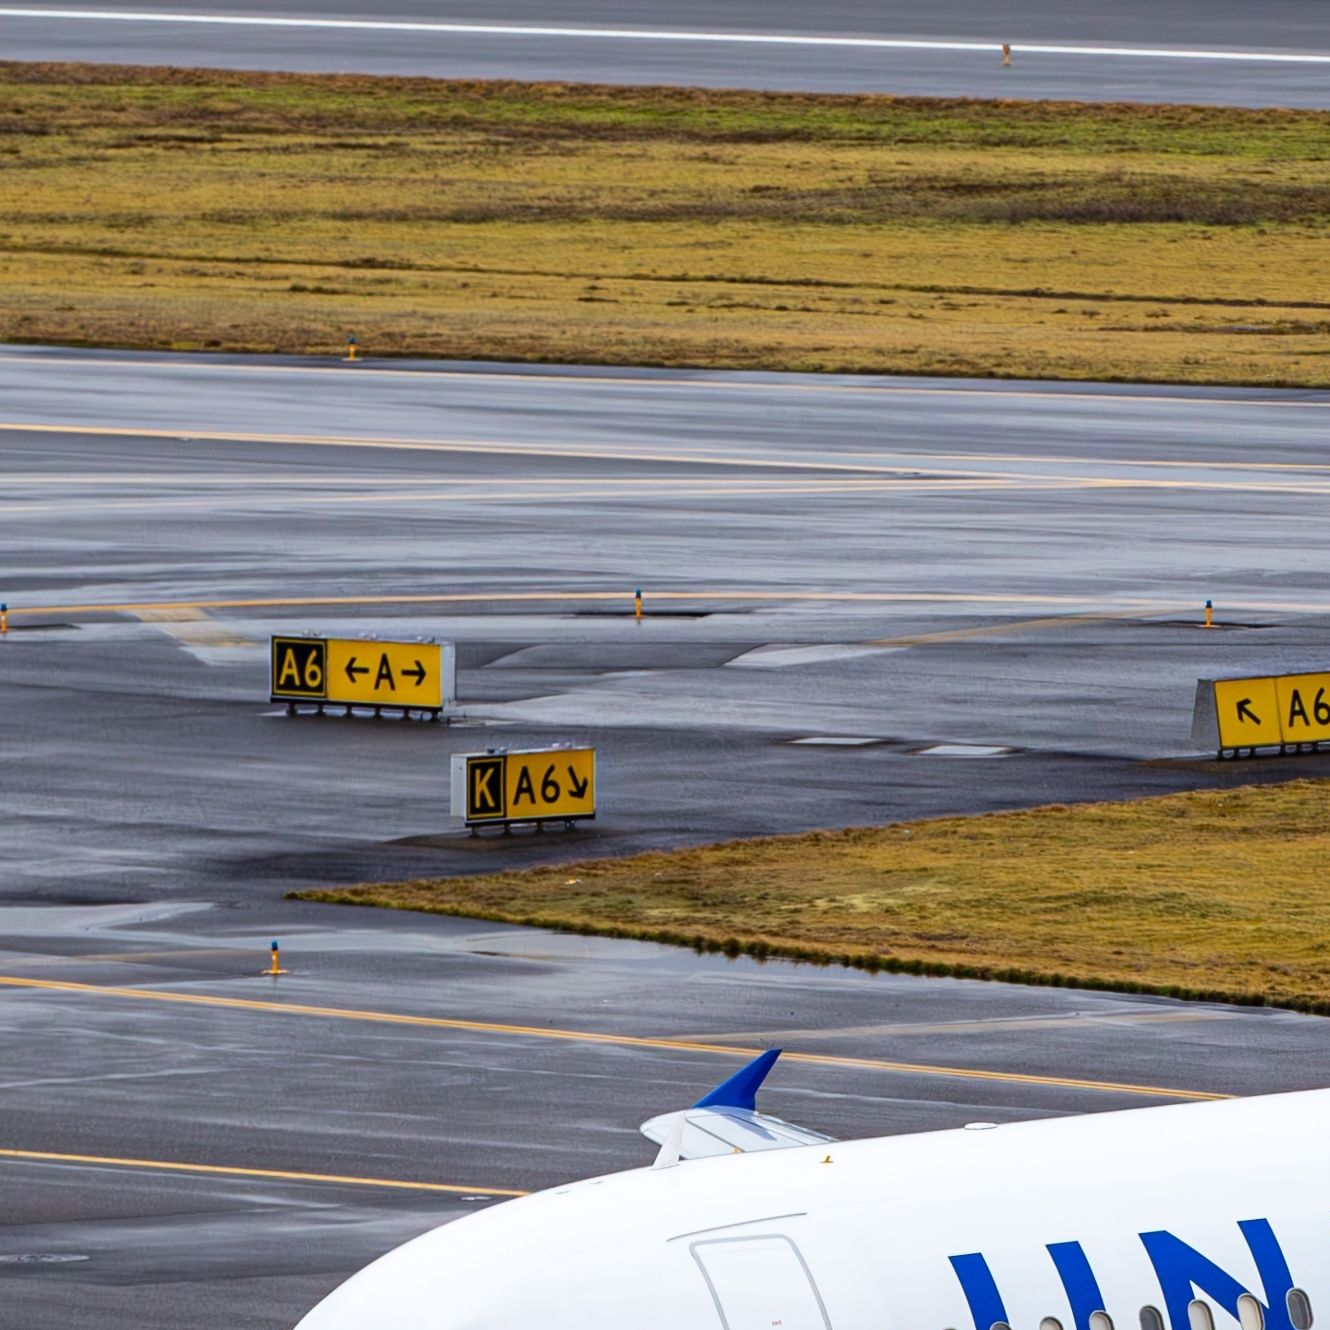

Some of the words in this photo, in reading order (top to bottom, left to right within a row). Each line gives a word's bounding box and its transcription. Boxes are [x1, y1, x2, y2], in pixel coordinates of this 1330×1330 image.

[279, 647, 322, 688] A6
[374, 653, 396, 691] A
[475, 767, 495, 809] K
[513, 763, 561, 806] A6
